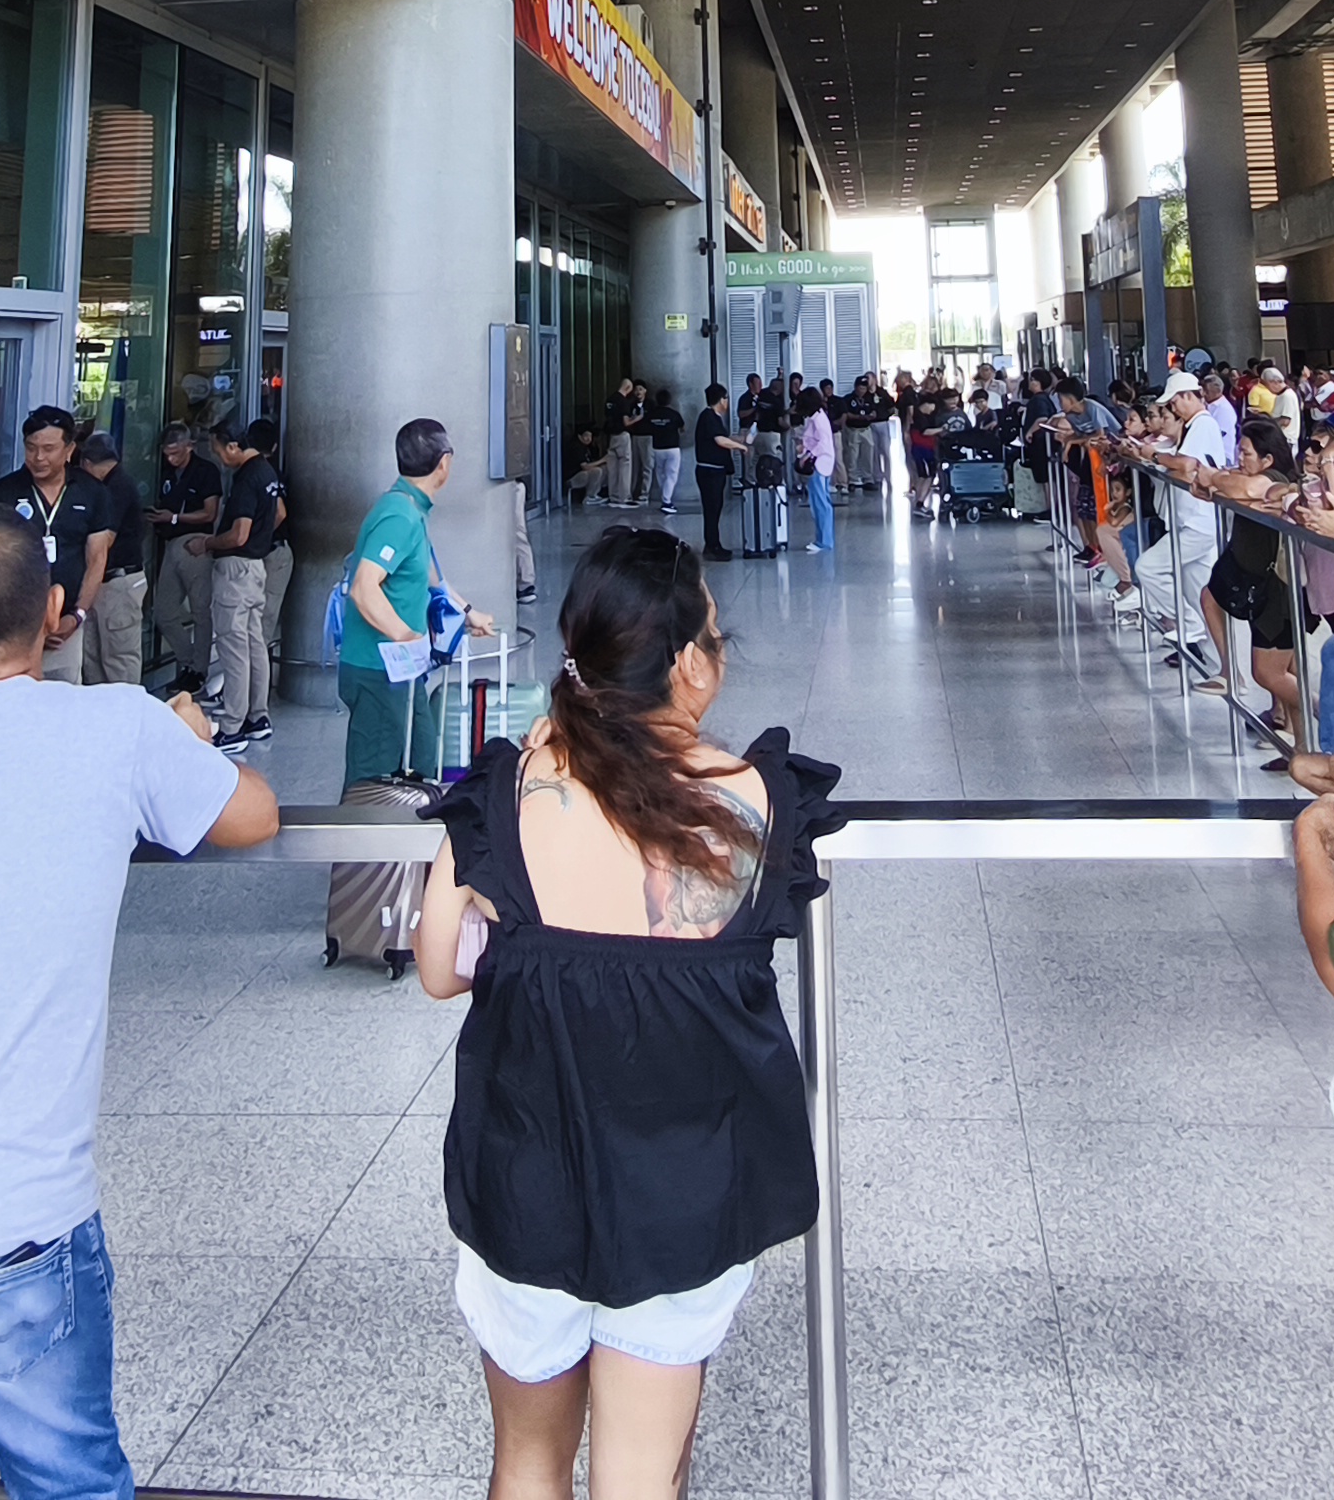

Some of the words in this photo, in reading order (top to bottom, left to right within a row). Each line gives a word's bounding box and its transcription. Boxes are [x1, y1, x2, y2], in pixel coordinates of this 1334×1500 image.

[619, 37, 635, 118] TO
[778, 259, 813, 275] GOOD
[831, 265, 845, 278] go
